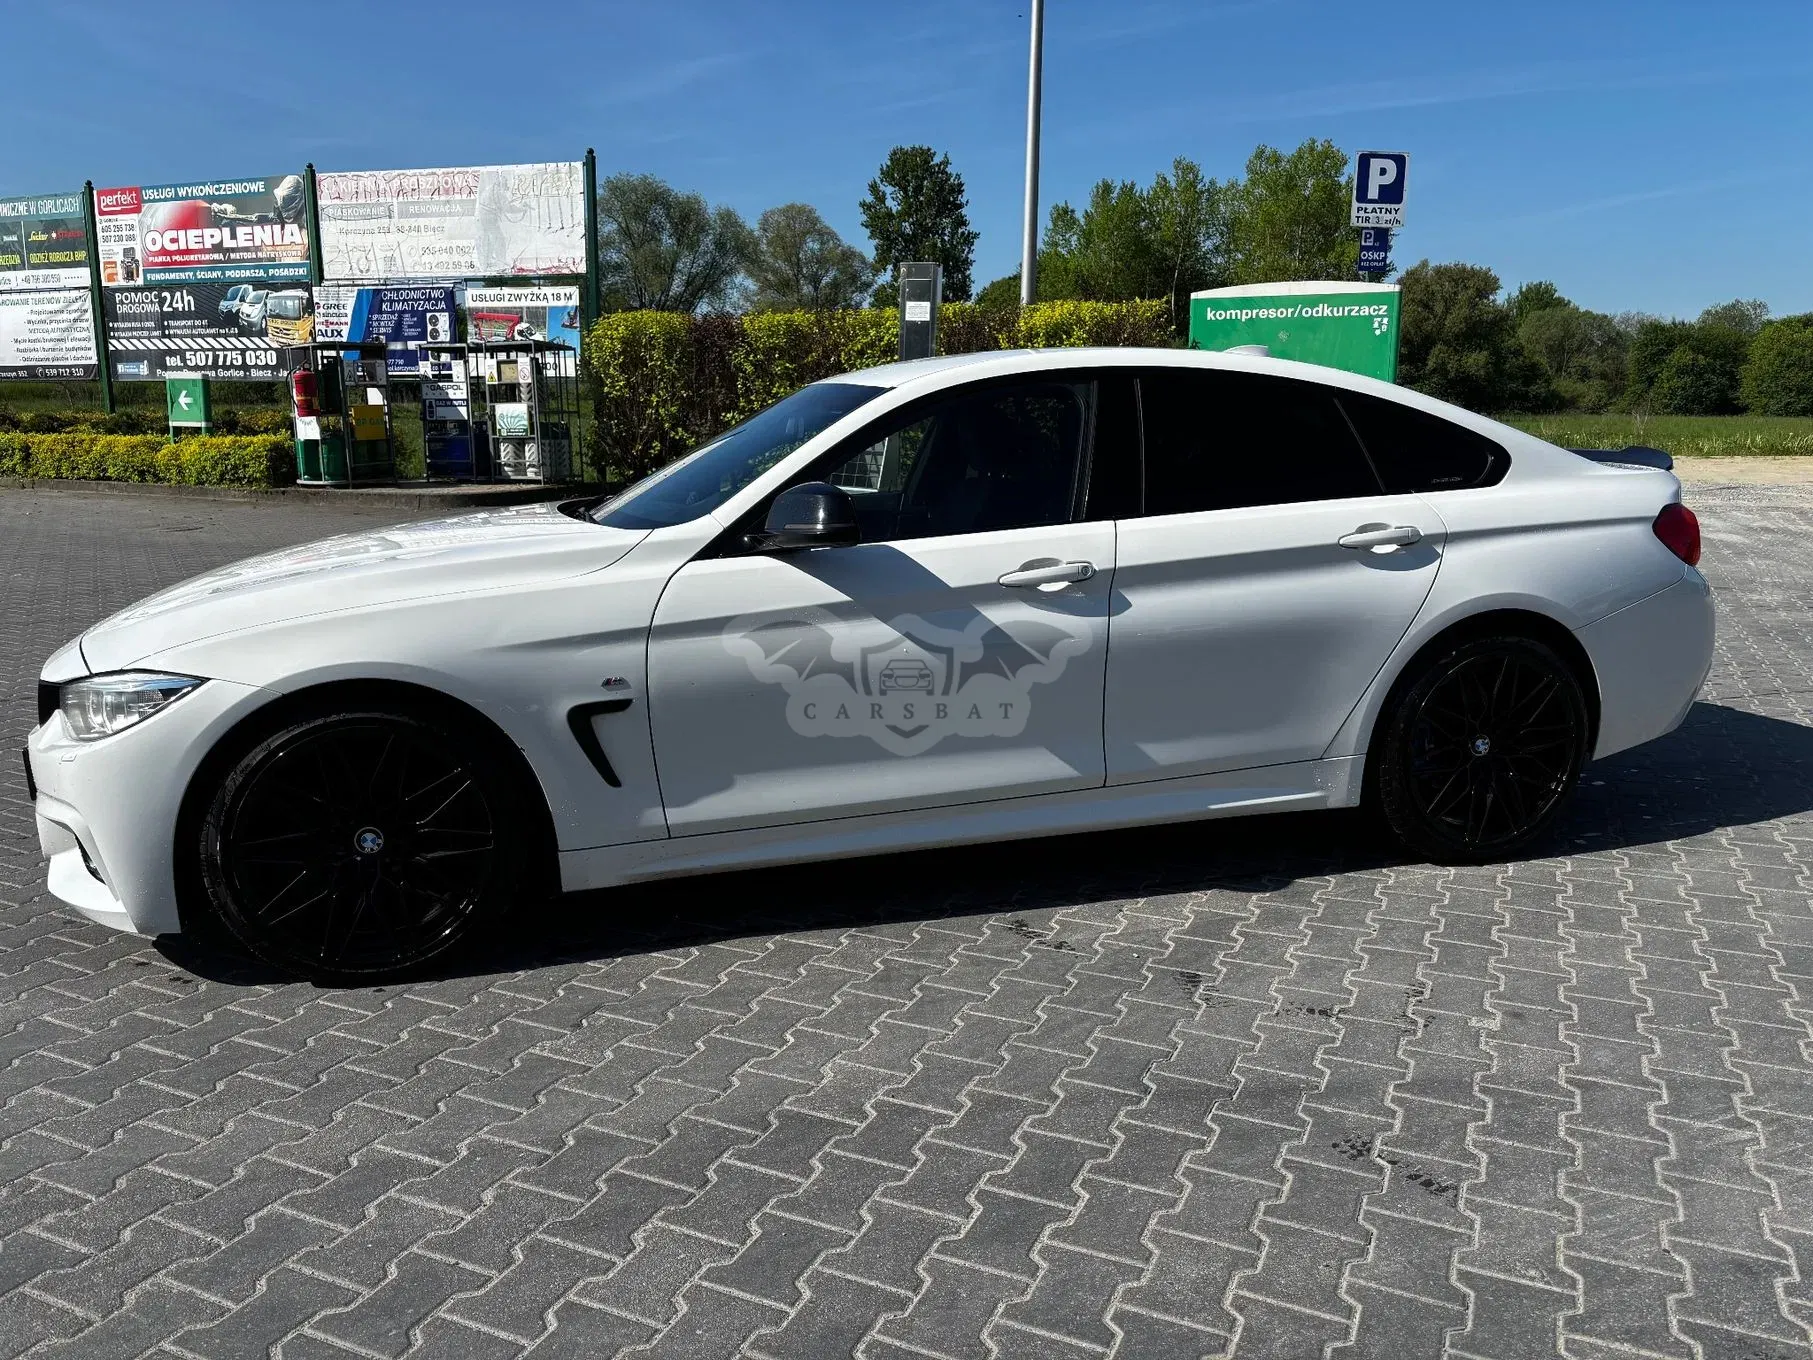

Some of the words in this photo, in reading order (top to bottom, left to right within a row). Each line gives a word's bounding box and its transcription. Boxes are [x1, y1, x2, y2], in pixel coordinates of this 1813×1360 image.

[1367, 158, 1397, 199] P
[142, 187, 175, 200] USŁUGI
[177, 181, 266, 198] WYKOŃCZENIOWE
[100, 190, 138, 207] perfekt
[329, 206, 385, 217] PIASKOWANIE
[409, 203, 462, 214] RENOWACJA
[1356, 206, 1401, 215] PŁATNY
[1355, 215, 1371, 224] TIR
[1384, 216, 1401, 226] zł/h
[145, 223, 304, 252] OCIEPLENIA
[1360, 251, 1386, 260] OSKP
[225, 269, 267, 278] PODDASZA,
[268, 267, 307, 276] POSADZKI
[381, 289, 445, 300] CHŁODNICTWO
[471, 293, 505, 303] USŁUGI
[507, 291, 550, 304] ZWYŻKĄ
[551, 293, 562, 301] 18
[564, 292, 573, 301] M
[115, 291, 159, 303] POMOC
[161, 289, 195, 312] 24h
[322, 302, 348, 310] GREE
[382, 300, 446, 312] KLIMATYZACJA
[116, 303, 160, 314] DROGOWA
[1206, 303, 1388, 322] kompresor/odkurzacz
[316, 329, 344, 338] AUX
[165, 355, 184, 367] tel.
[186, 351, 213, 367] 507
[216, 350, 242, 366] 775
[246, 350, 277, 366] 030
[45, 368, 58, 377] 539
[59, 368, 72, 377] 712
[72, 367, 85, 377] 310
[217, 369, 245, 377] Gorlice
[250, 369, 272, 377] Biecz
